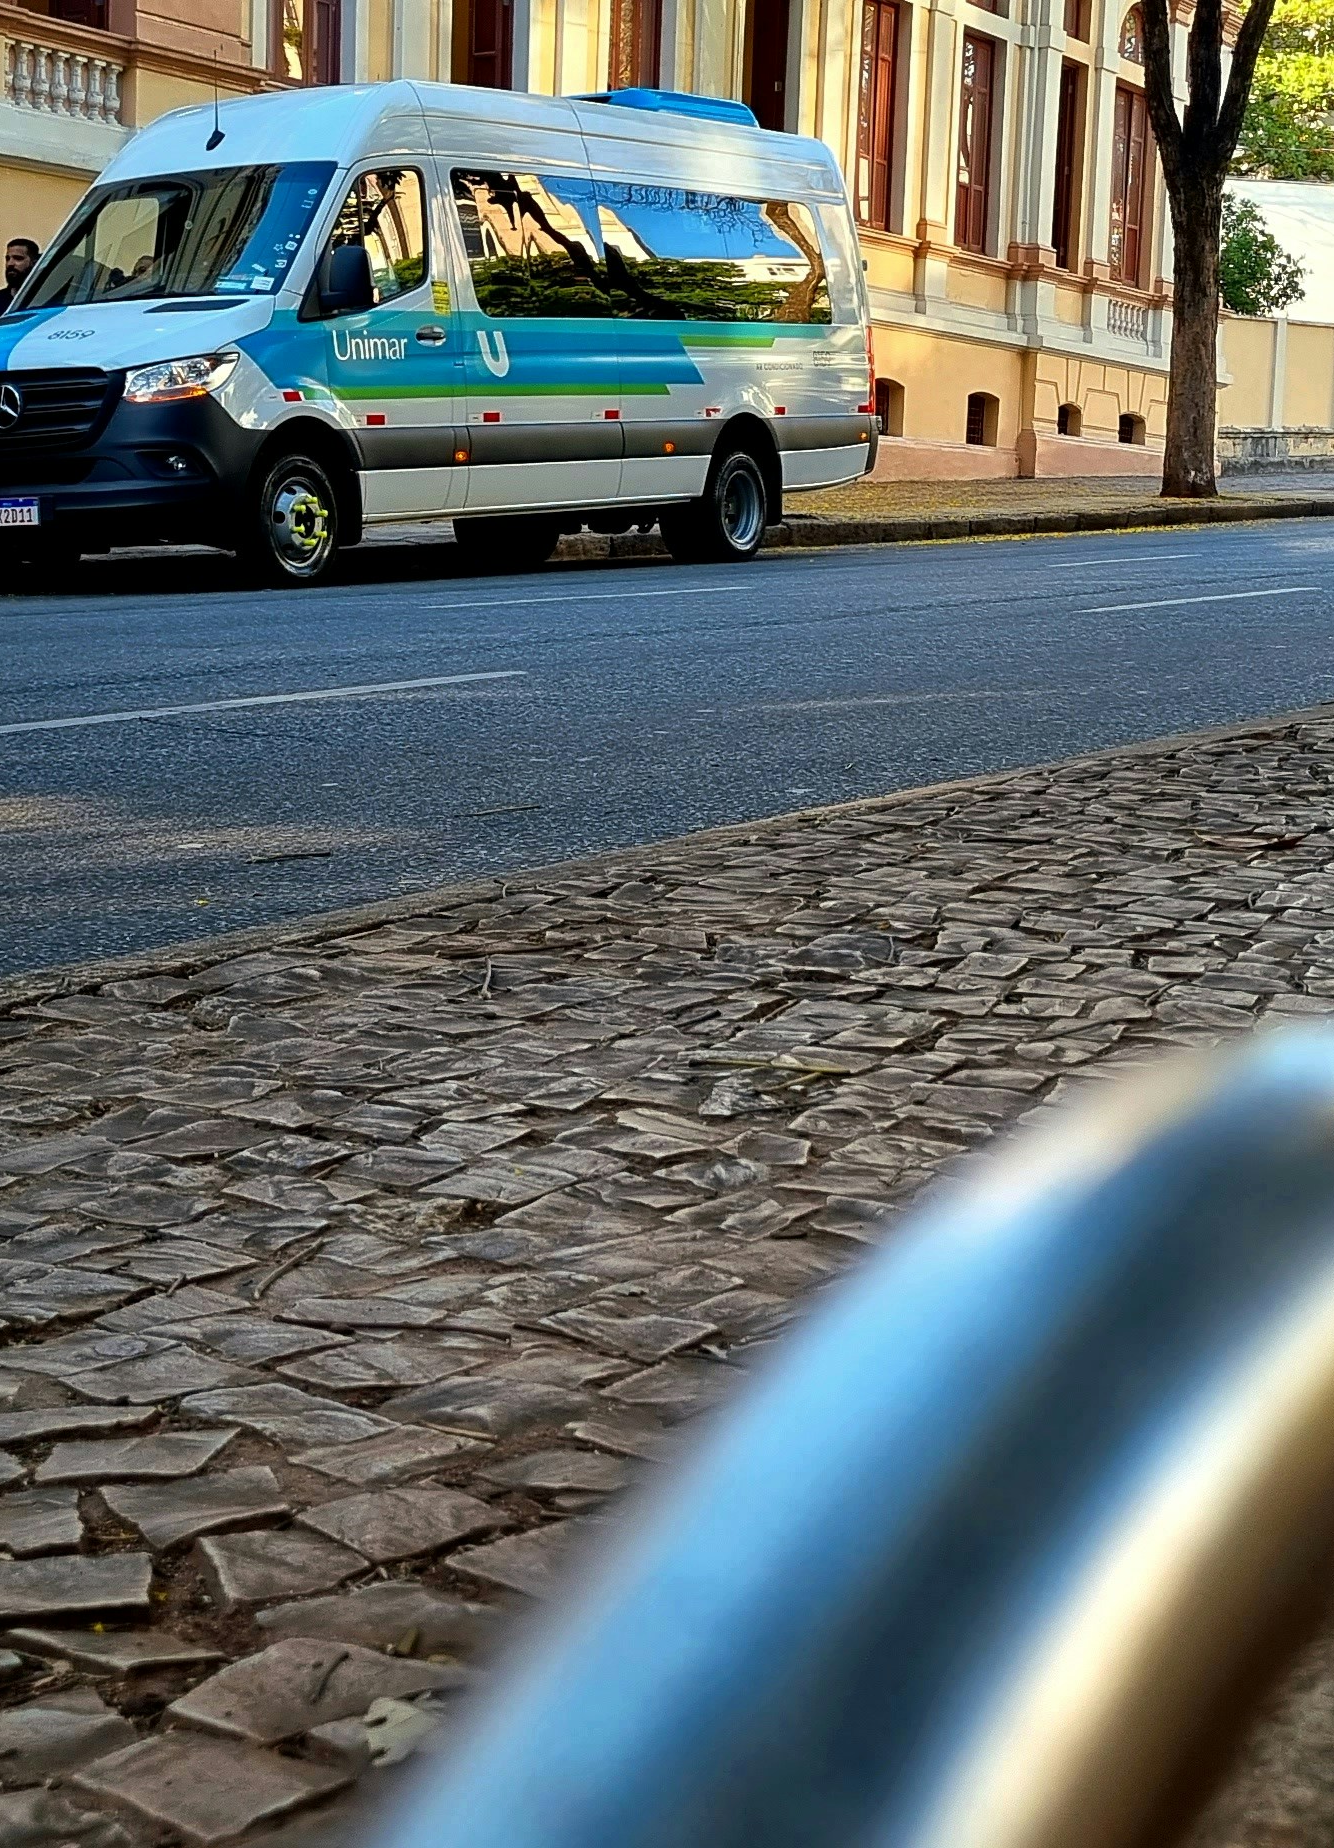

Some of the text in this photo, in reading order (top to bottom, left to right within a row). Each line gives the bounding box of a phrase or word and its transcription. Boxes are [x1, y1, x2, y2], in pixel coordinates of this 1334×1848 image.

[47, 330, 95, 340] 8159
[332, 329, 408, 361] Unimar
[476, 330, 510, 378] U
